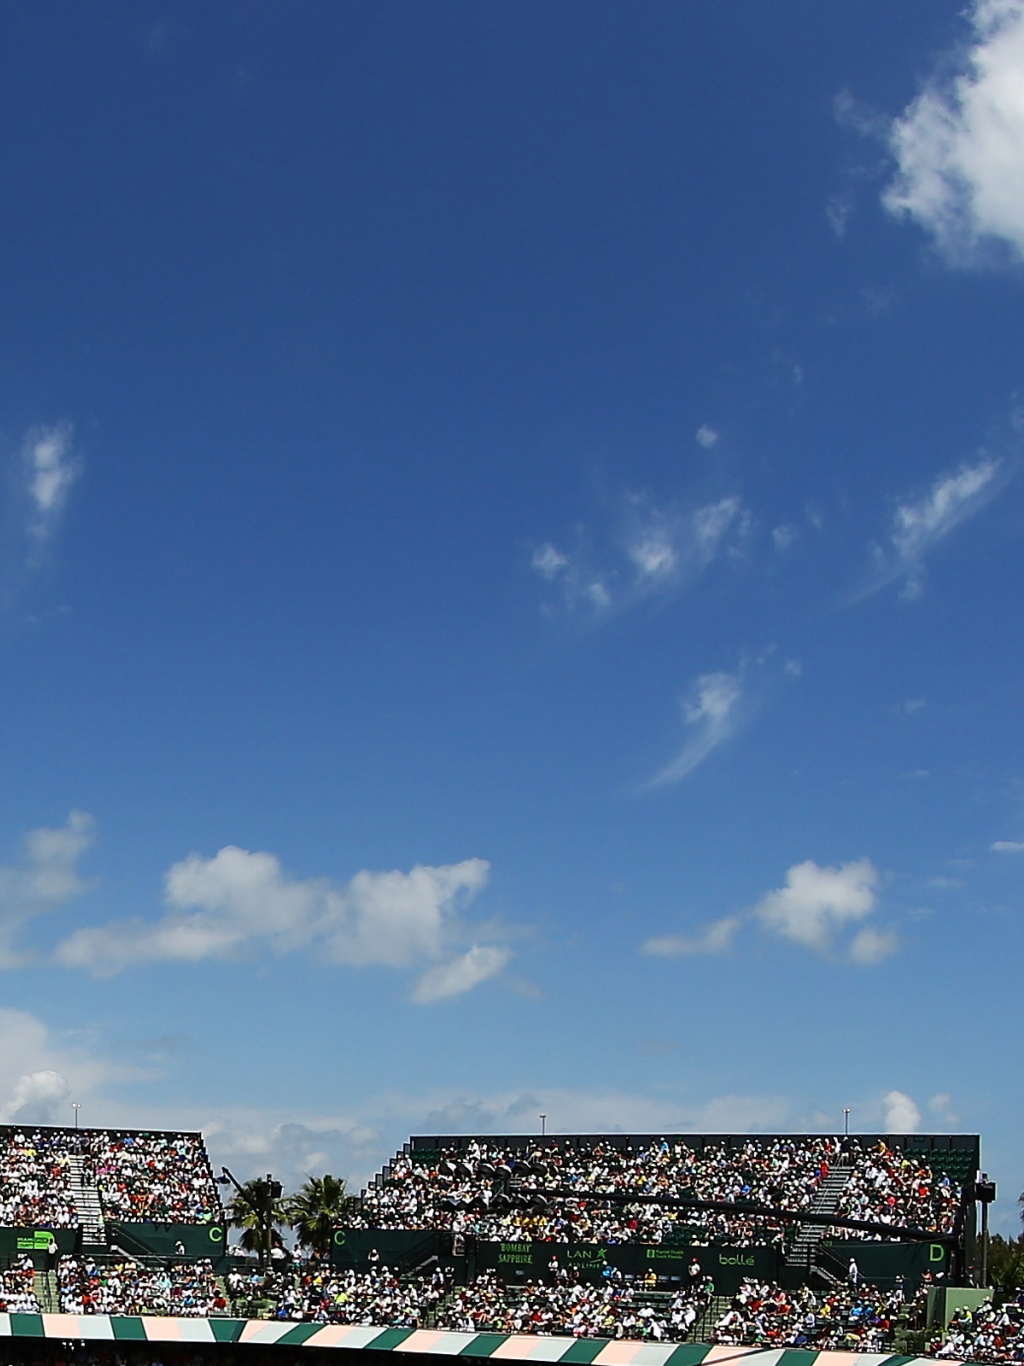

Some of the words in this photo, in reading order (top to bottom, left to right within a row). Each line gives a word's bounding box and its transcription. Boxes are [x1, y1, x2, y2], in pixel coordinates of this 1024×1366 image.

[209, 1226, 223, 1242] C
[334, 1230, 346, 1245] C
[500, 1243, 533, 1252] BOMBAY
[566, 1250, 592, 1258] LAN
[929, 1244, 945, 1262] D
[497, 1254, 533, 1264] SAPPHIRE
[719, 1253, 755, 1266] bollé
